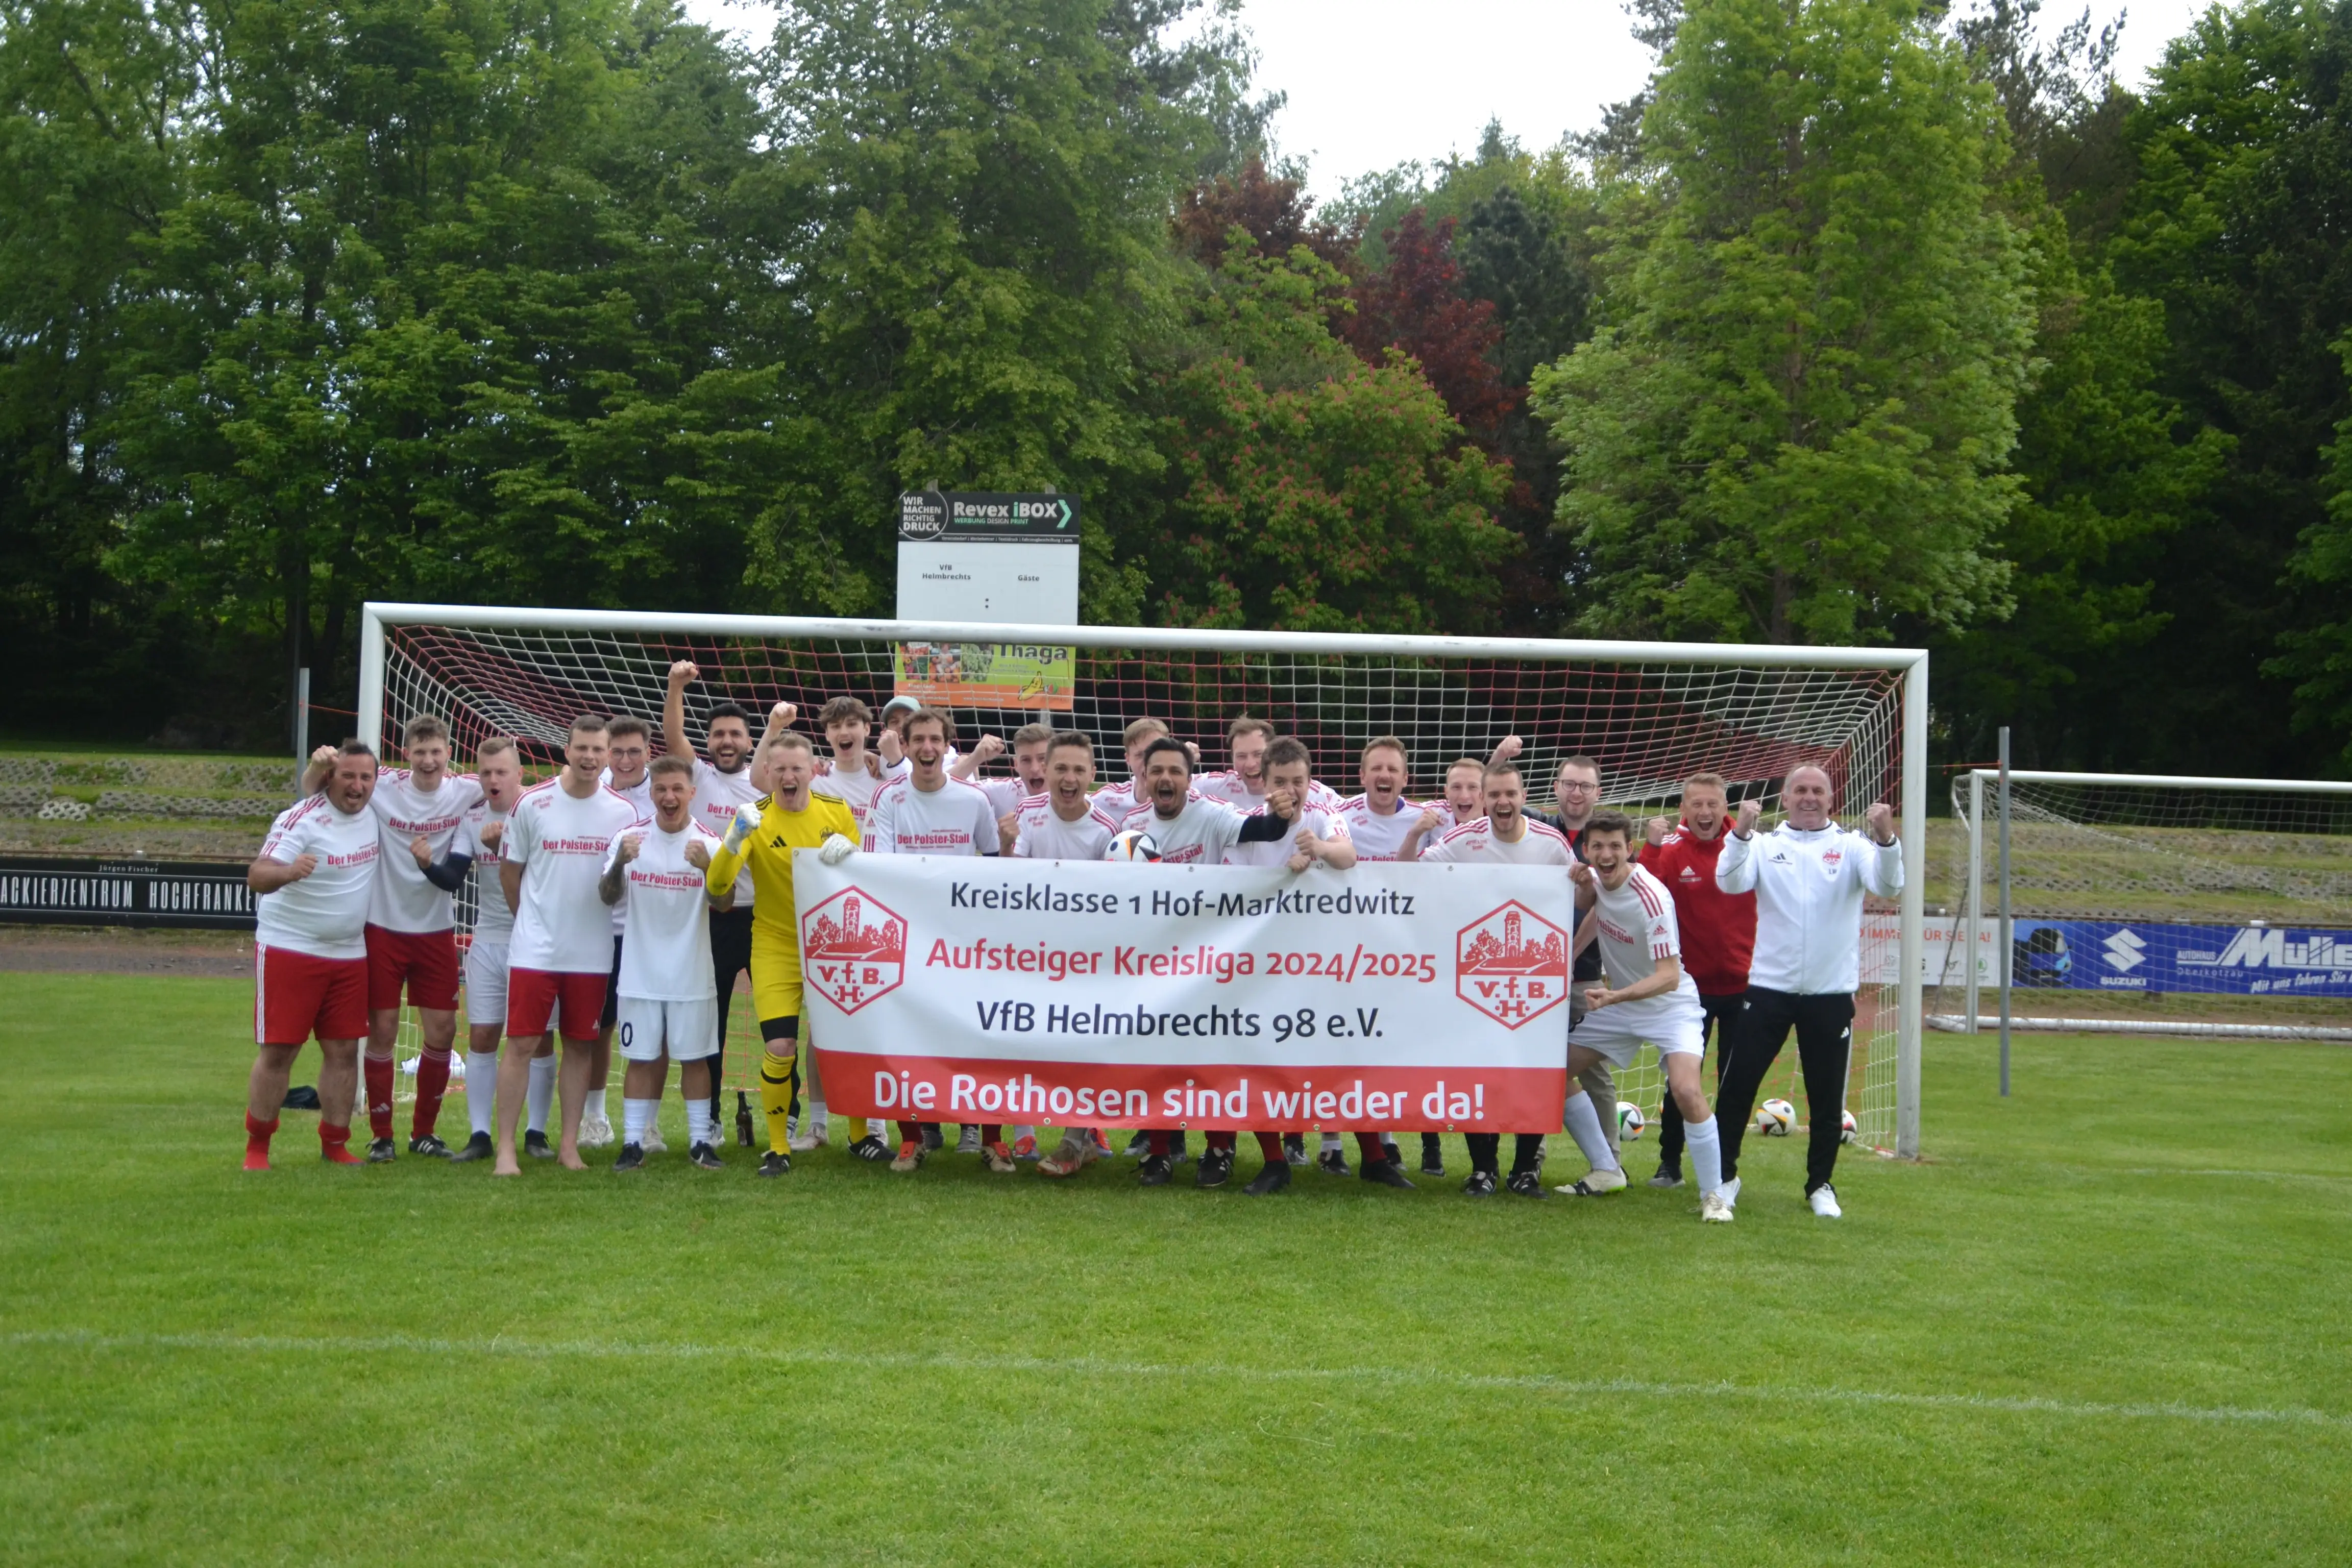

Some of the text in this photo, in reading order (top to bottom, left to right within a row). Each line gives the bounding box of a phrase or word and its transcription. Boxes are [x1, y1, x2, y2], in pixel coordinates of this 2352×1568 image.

[903, 496, 923, 505] WIR
[903, 506, 941, 514] MACHEN
[953, 501, 1057, 518] Revex iBOX
[903, 522, 940, 531] DRUCK
[707, 802, 723, 815] Der
[389, 817, 406, 829] Der
[409, 816, 460, 832] Polster-Stall
[543, 839, 609, 851] Der Polster-Sta
[898, 832, 969, 845] Der Polster-Stall
[327, 854, 345, 865] Der
[99, 864, 126, 872] Jürgen
[630, 870, 648, 881] Der
[649, 871, 703, 888] Polster-Stall
[951, 883, 1414, 917] Kreisklasse 1 Hof-Marktredwitz
[1924, 927, 1942, 941] ÜR
[1978, 932, 1991, 942] A!
[926, 938, 1436, 984] Aufsteiger Kreisliga 2024/2025
[2176, 950, 2216, 961] AUTOHAUS
[2100, 976, 2147, 986] SUZUKI
[2250, 970, 2346, 994] Mit uns fahren Sie
[977, 1001, 1383, 1043] VfB Helmbrechts 98 e.V.
[875, 1070, 1484, 1119] Die Rothosen sind wieder da!
